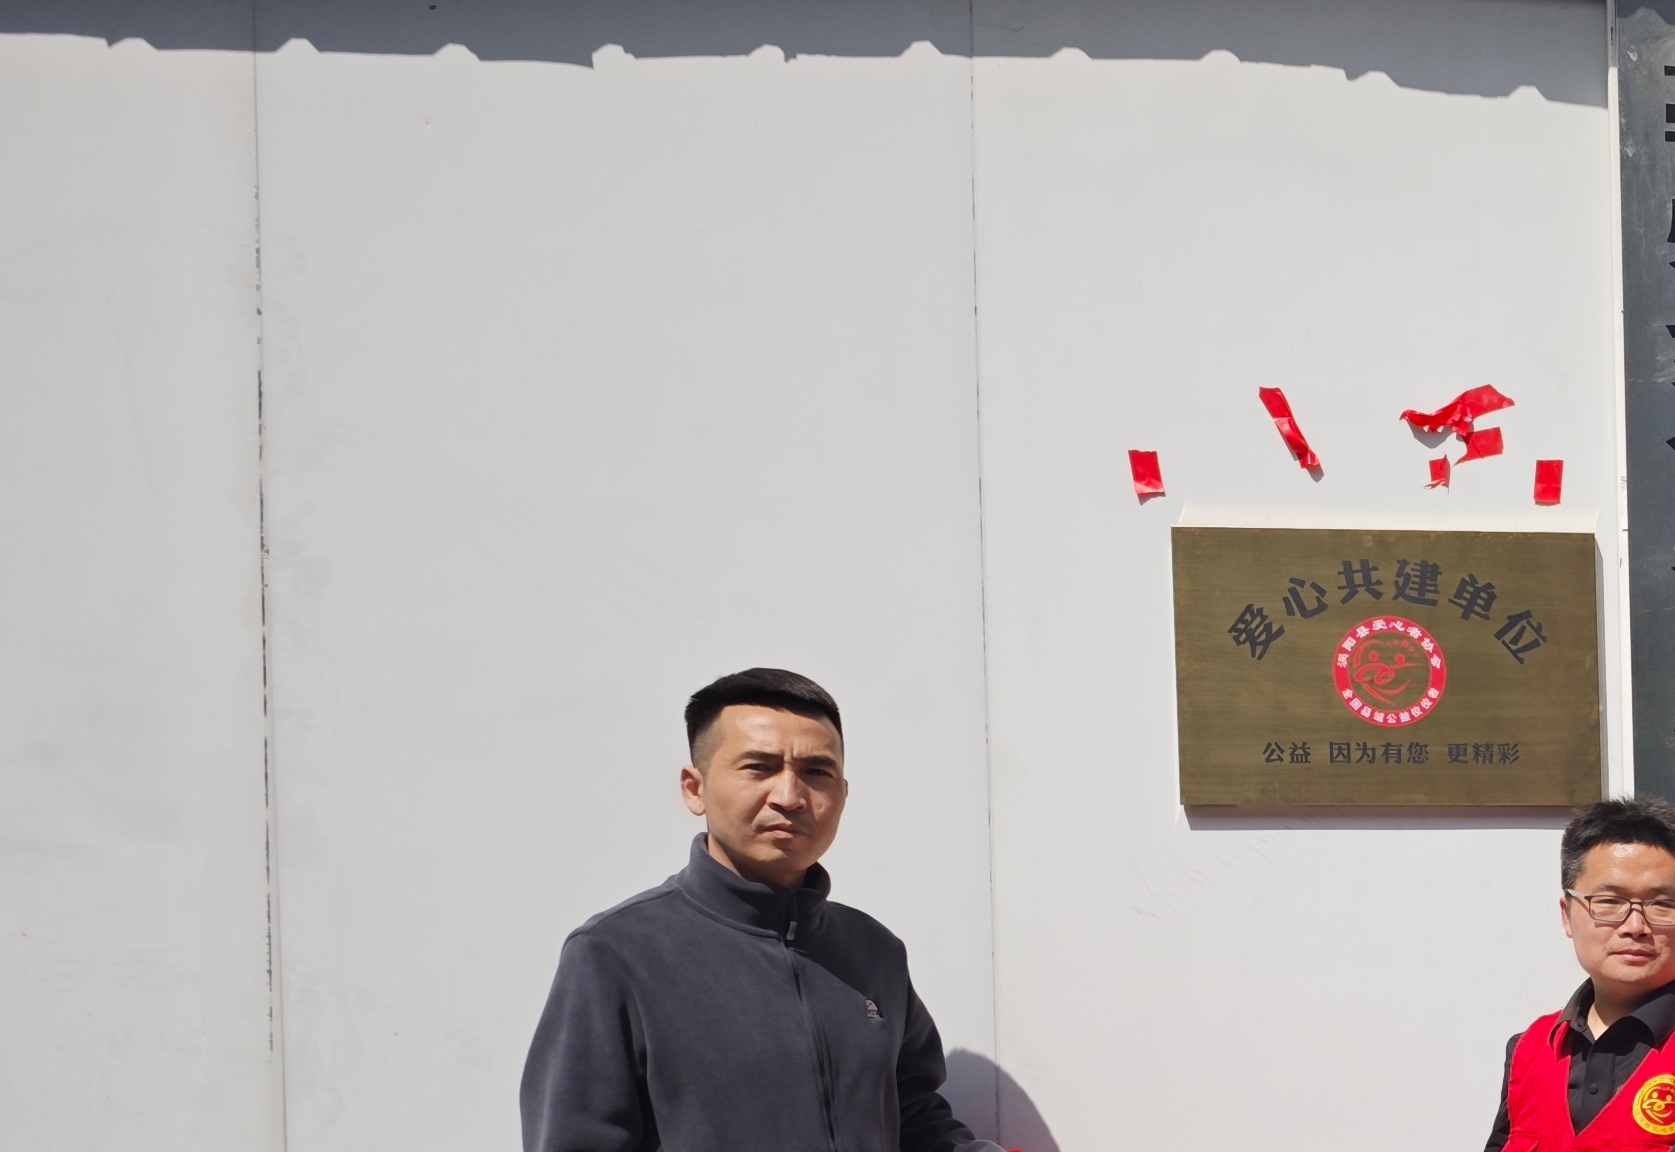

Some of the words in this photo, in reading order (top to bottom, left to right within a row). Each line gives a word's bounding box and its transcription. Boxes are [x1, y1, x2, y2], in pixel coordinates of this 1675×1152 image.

[1227, 558, 1548, 664] 爱心共建单位
[1262, 741, 1312, 764] 公益
[1328, 741, 1429, 764] 因为有您
[1447, 742, 1520, 764] 更精彩
